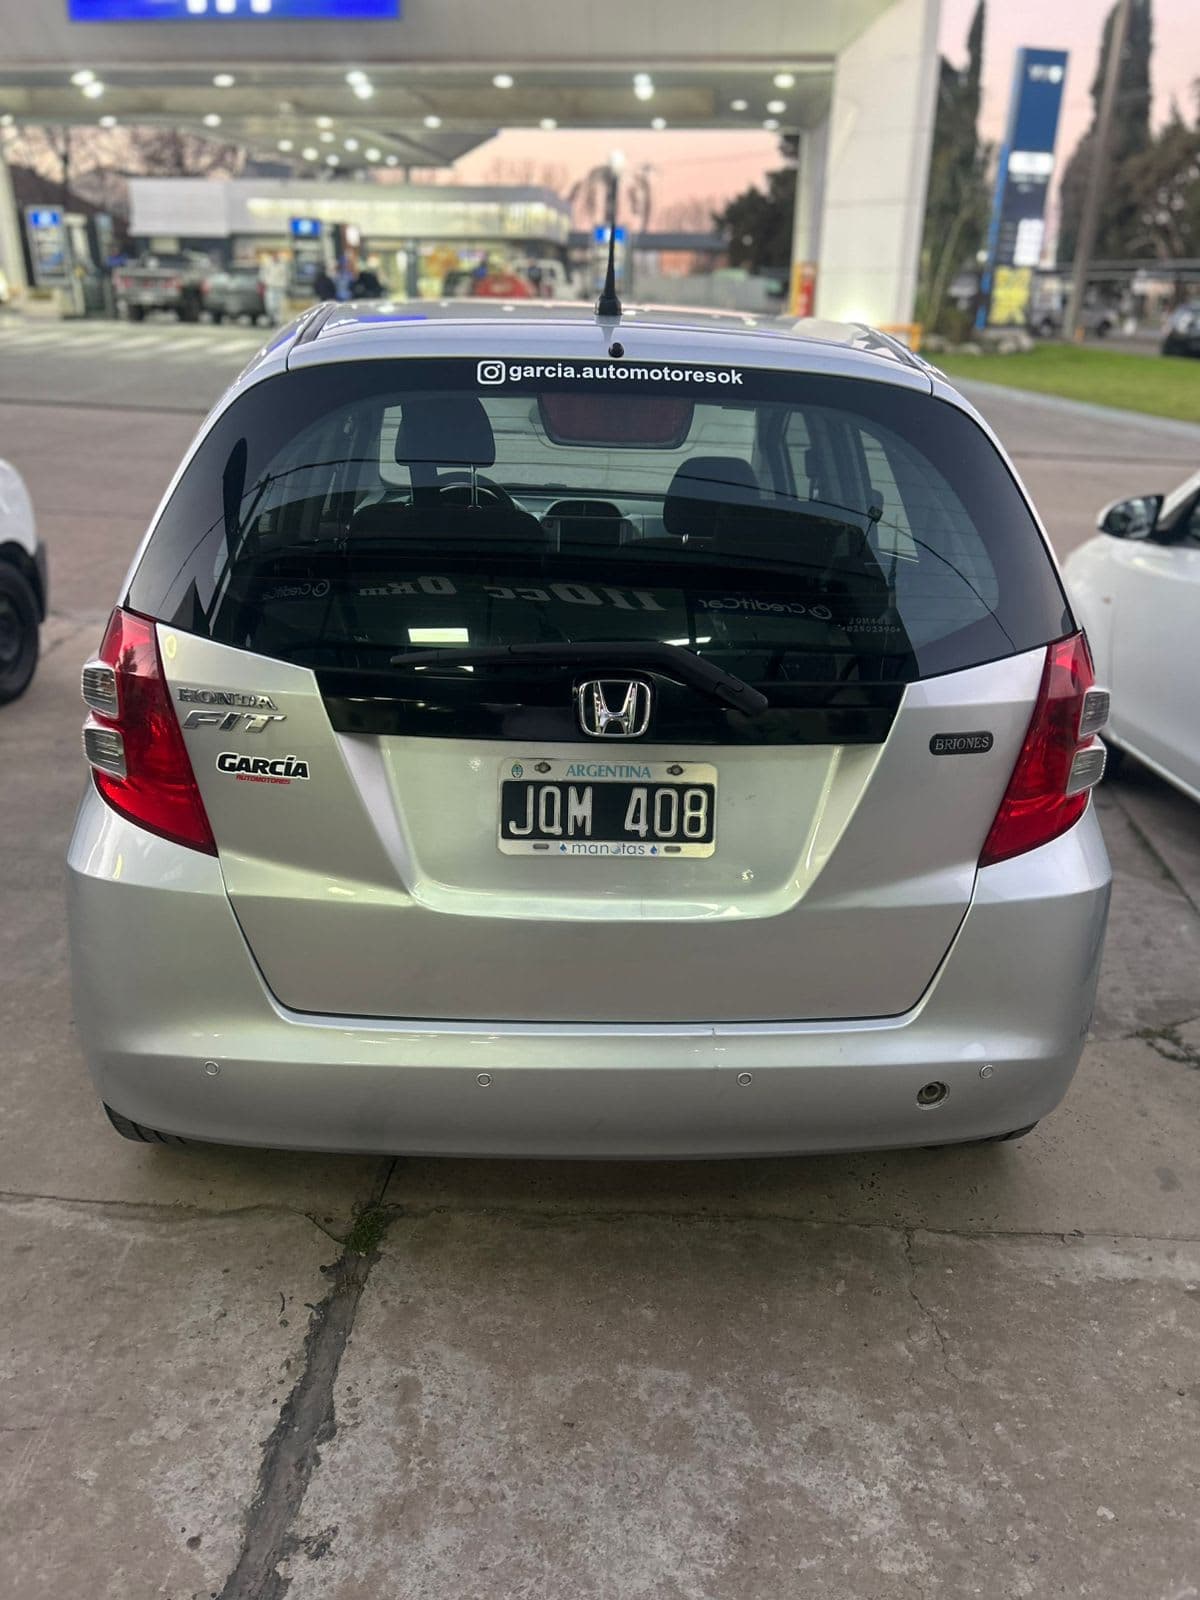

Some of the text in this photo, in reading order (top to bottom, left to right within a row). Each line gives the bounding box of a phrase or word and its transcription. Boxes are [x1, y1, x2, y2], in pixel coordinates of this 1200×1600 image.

[508, 364, 744, 385] garcia.automotoresok
[182, 710, 287, 734] FIT
[935, 736, 990, 750] BRIONES
[565, 764, 652, 778] ARGENTINA
[508, 785, 709, 838] JQM 408
